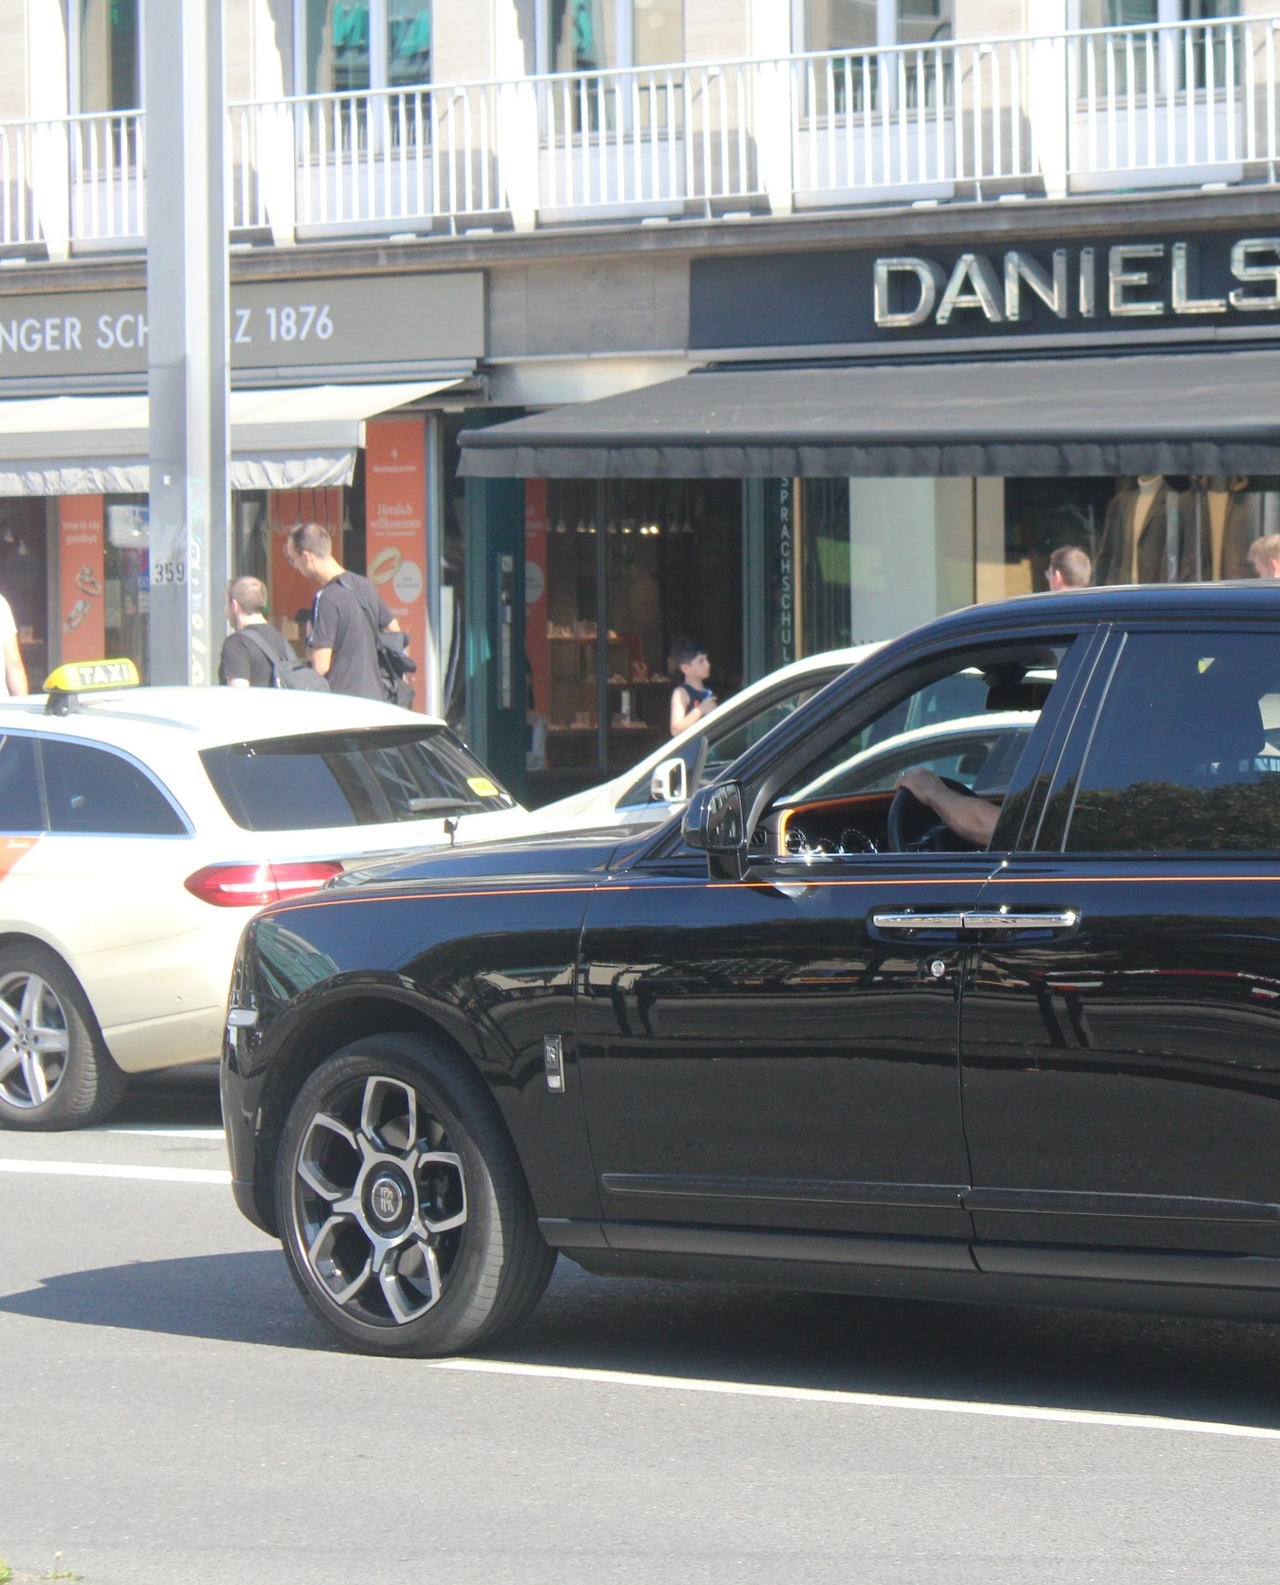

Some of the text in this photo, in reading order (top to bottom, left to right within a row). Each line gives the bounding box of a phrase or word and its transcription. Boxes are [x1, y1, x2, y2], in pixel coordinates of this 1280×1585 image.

[266, 304, 334, 342] 1876
[154, 562, 184, 582] 359
[79, 663, 130, 685] TAXI
